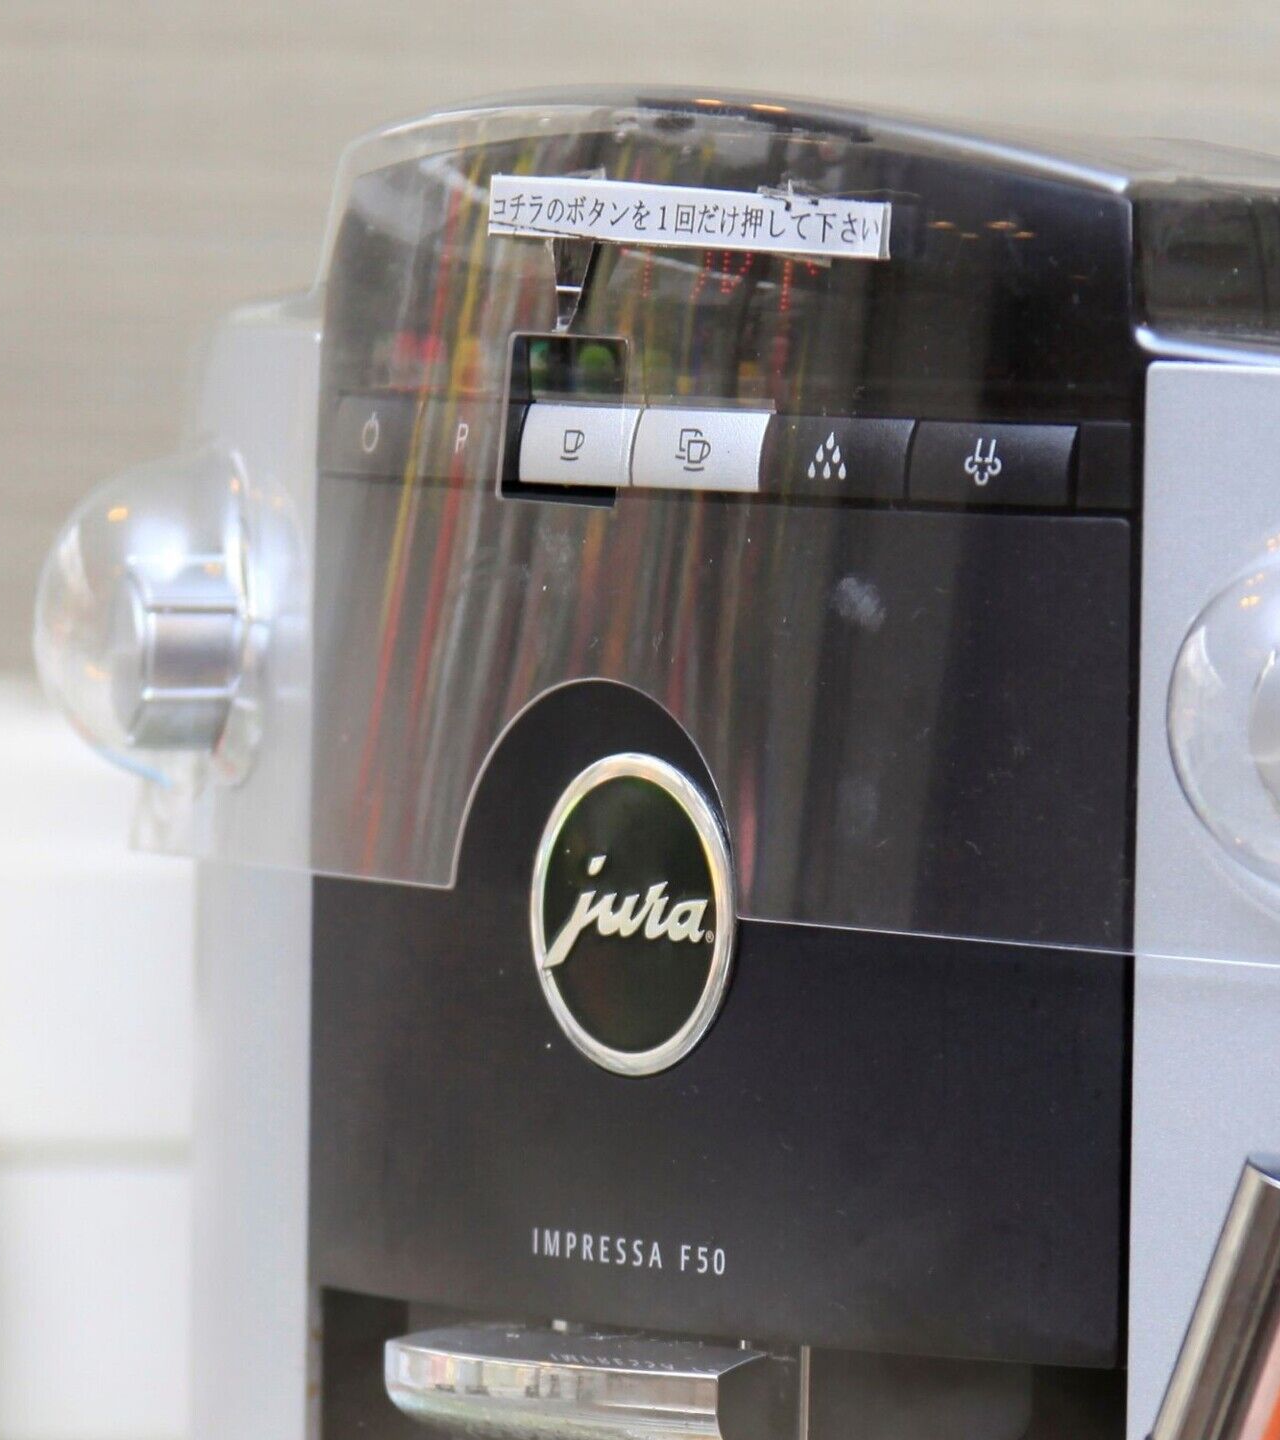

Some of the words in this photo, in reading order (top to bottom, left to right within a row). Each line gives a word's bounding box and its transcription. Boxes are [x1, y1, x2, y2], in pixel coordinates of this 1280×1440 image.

[491, 195, 881, 242] コチラのボタンを1回だけ押して下さい
[531, 1227, 663, 1269] IMPRESSA
[680, 1244, 726, 1275] F50
